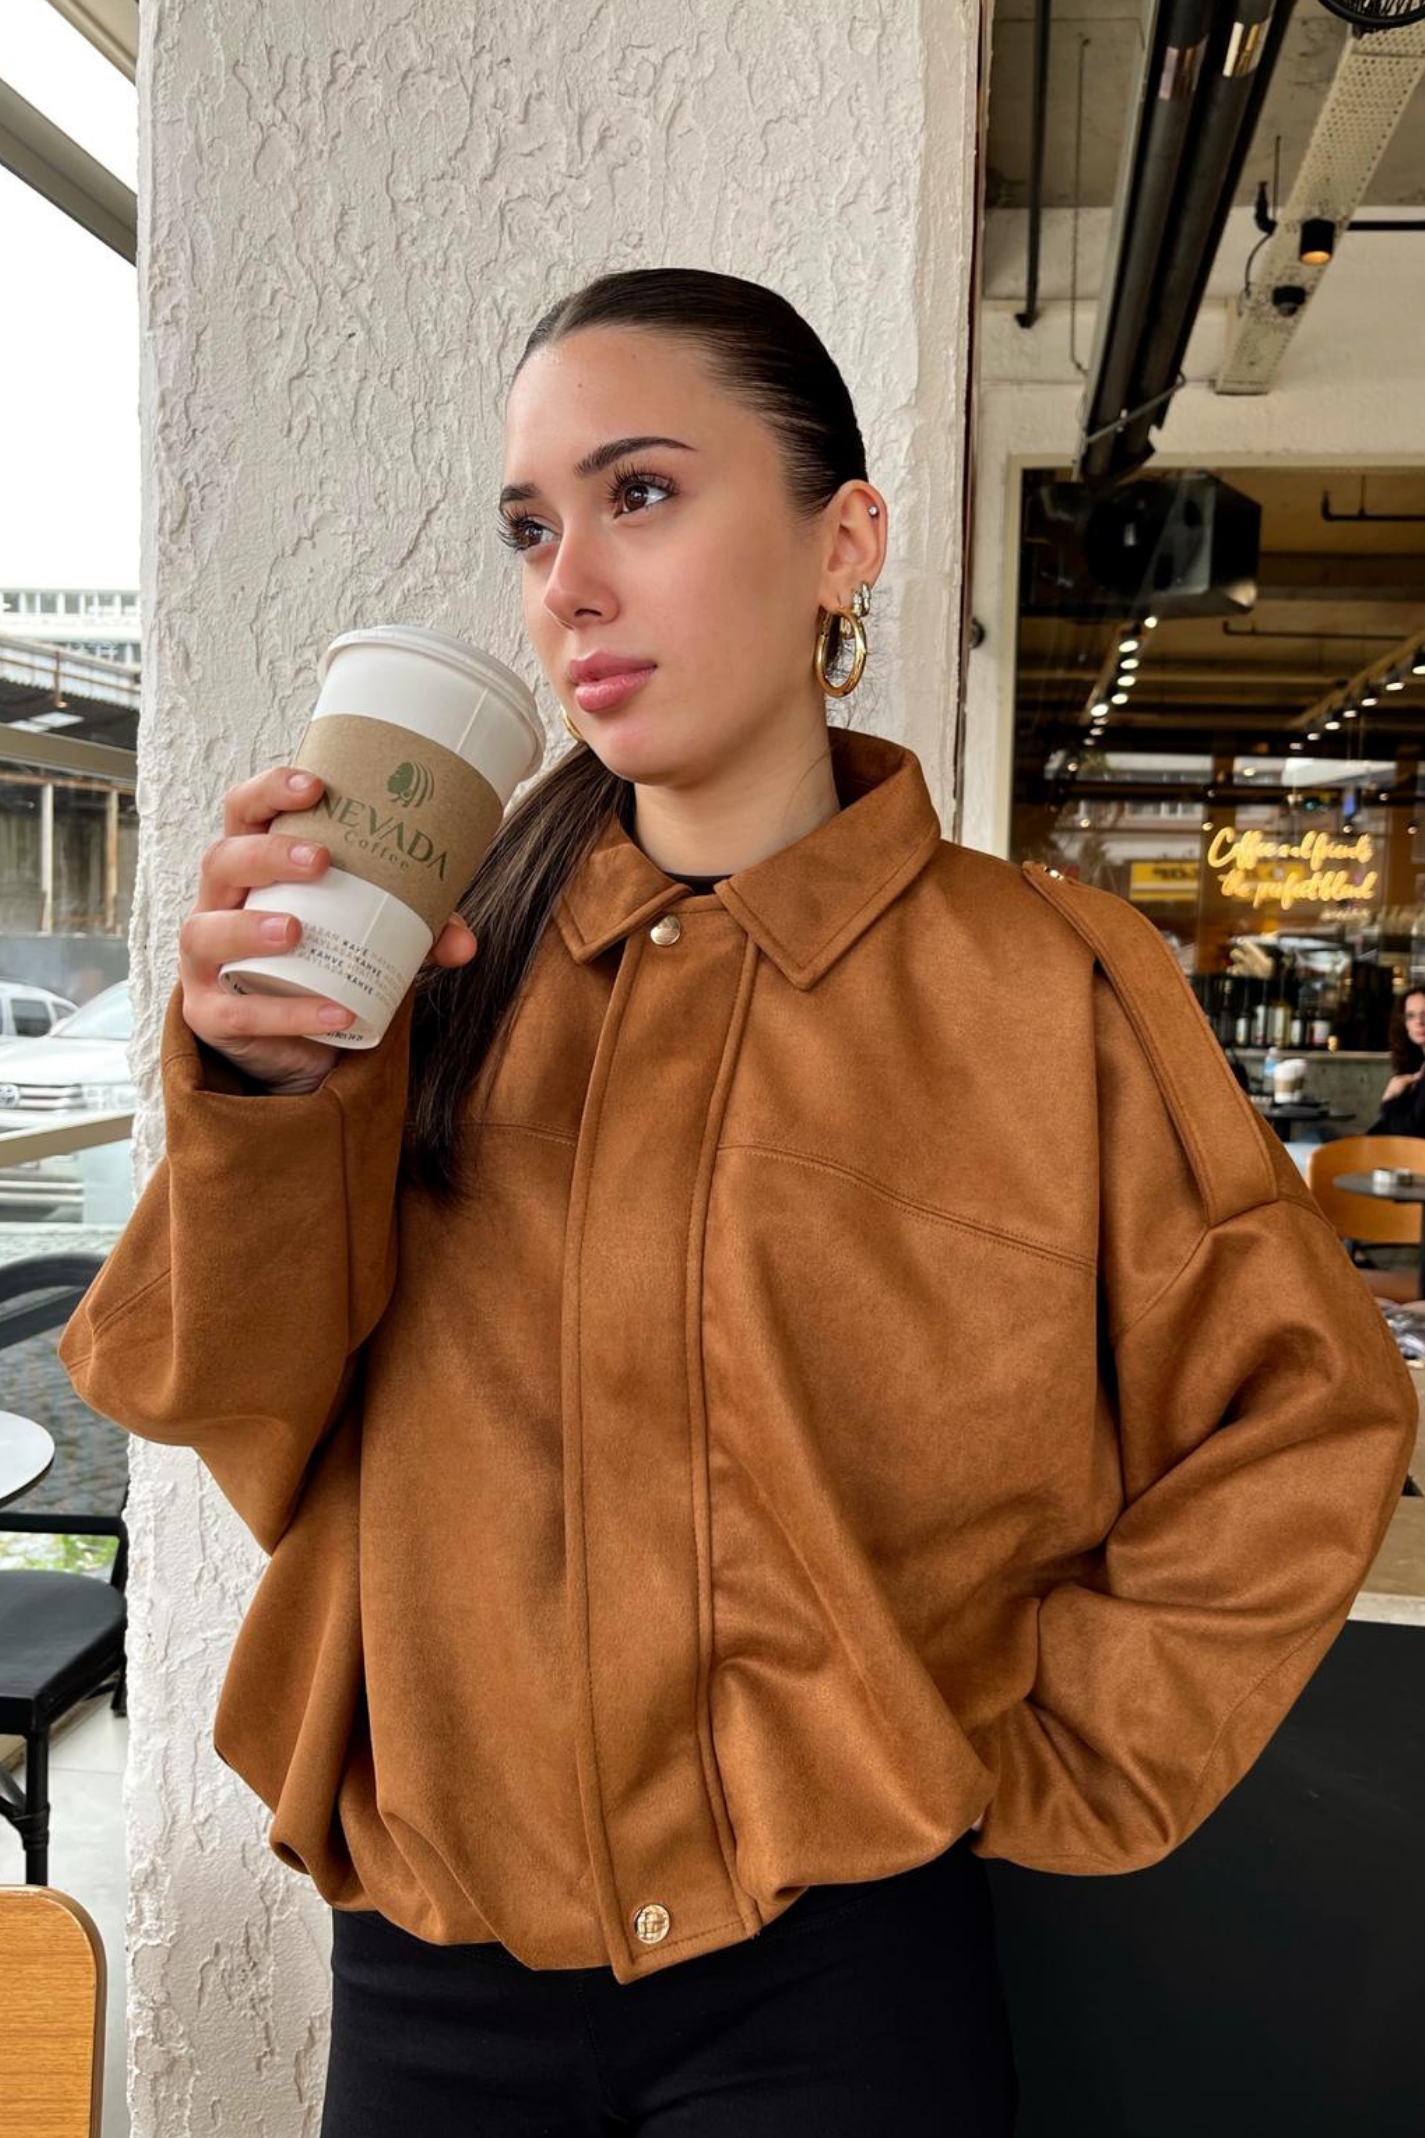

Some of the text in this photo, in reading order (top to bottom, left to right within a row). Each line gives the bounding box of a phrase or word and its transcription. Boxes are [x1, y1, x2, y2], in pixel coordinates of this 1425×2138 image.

[312, 789, 448, 882] NEVADA
[344, 830, 410, 870] Coffee
[1207, 826, 1278, 870] Coffee
